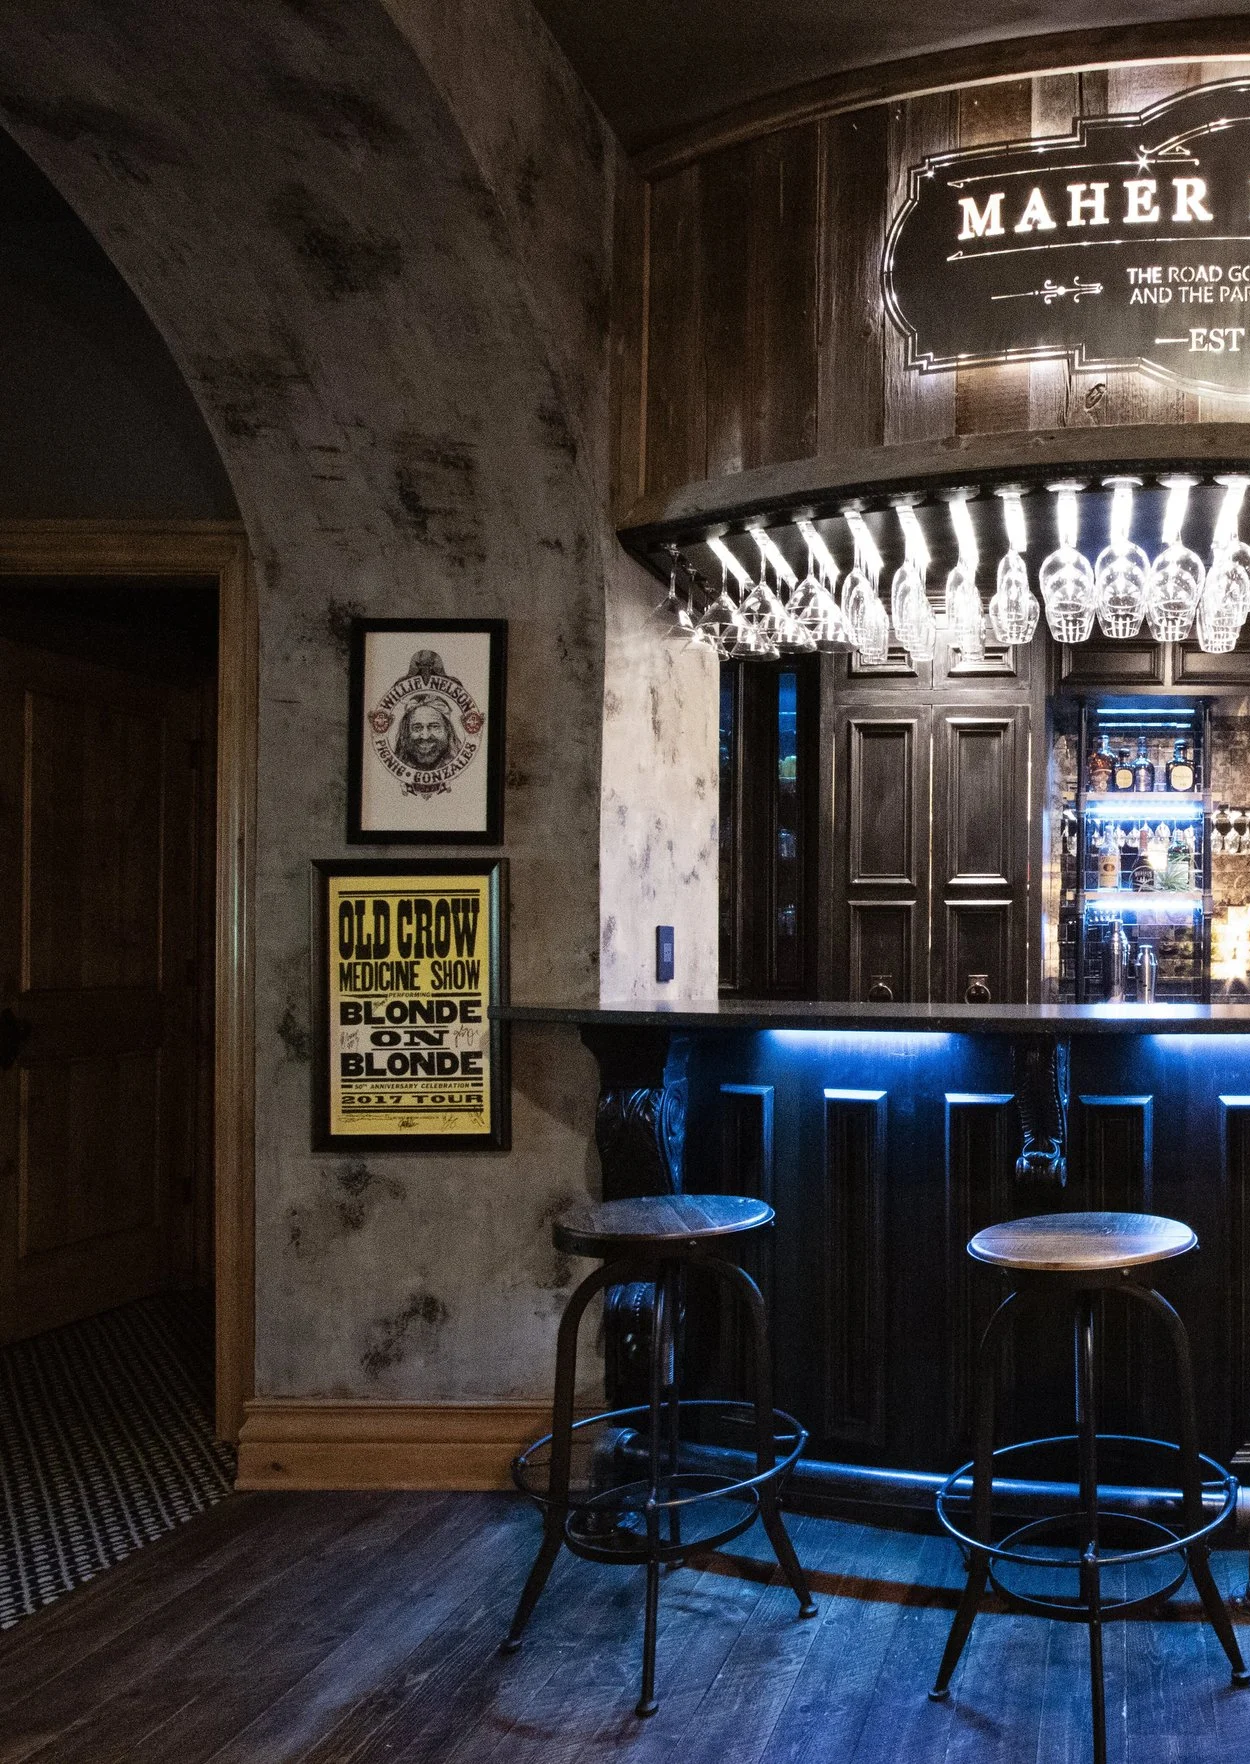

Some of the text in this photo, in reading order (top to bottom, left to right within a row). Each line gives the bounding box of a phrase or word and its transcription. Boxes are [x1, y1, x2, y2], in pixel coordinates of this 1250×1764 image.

[958, 178, 1213, 240] MAHER
[1127, 267, 1162, 284] THE
[1169, 265, 1222, 283] ROAD
[1130, 287, 1172, 304] AND
[1178, 287, 1214, 303] THE
[1189, 328, 1245, 352] EST
[381, 677, 475, 713] WILLIE NELSON
[414, 741, 477, 783] GONZALES
[339, 898, 480, 960] OLD CROW
[339, 960, 480, 992] MEDICINE SHOW
[340, 1000, 482, 1026] BLONDE
[370, 1029, 450, 1047] ON
[341, 1051, 483, 1077] BLONDE
[341, 1094, 483, 1104] 2017 TOUR
